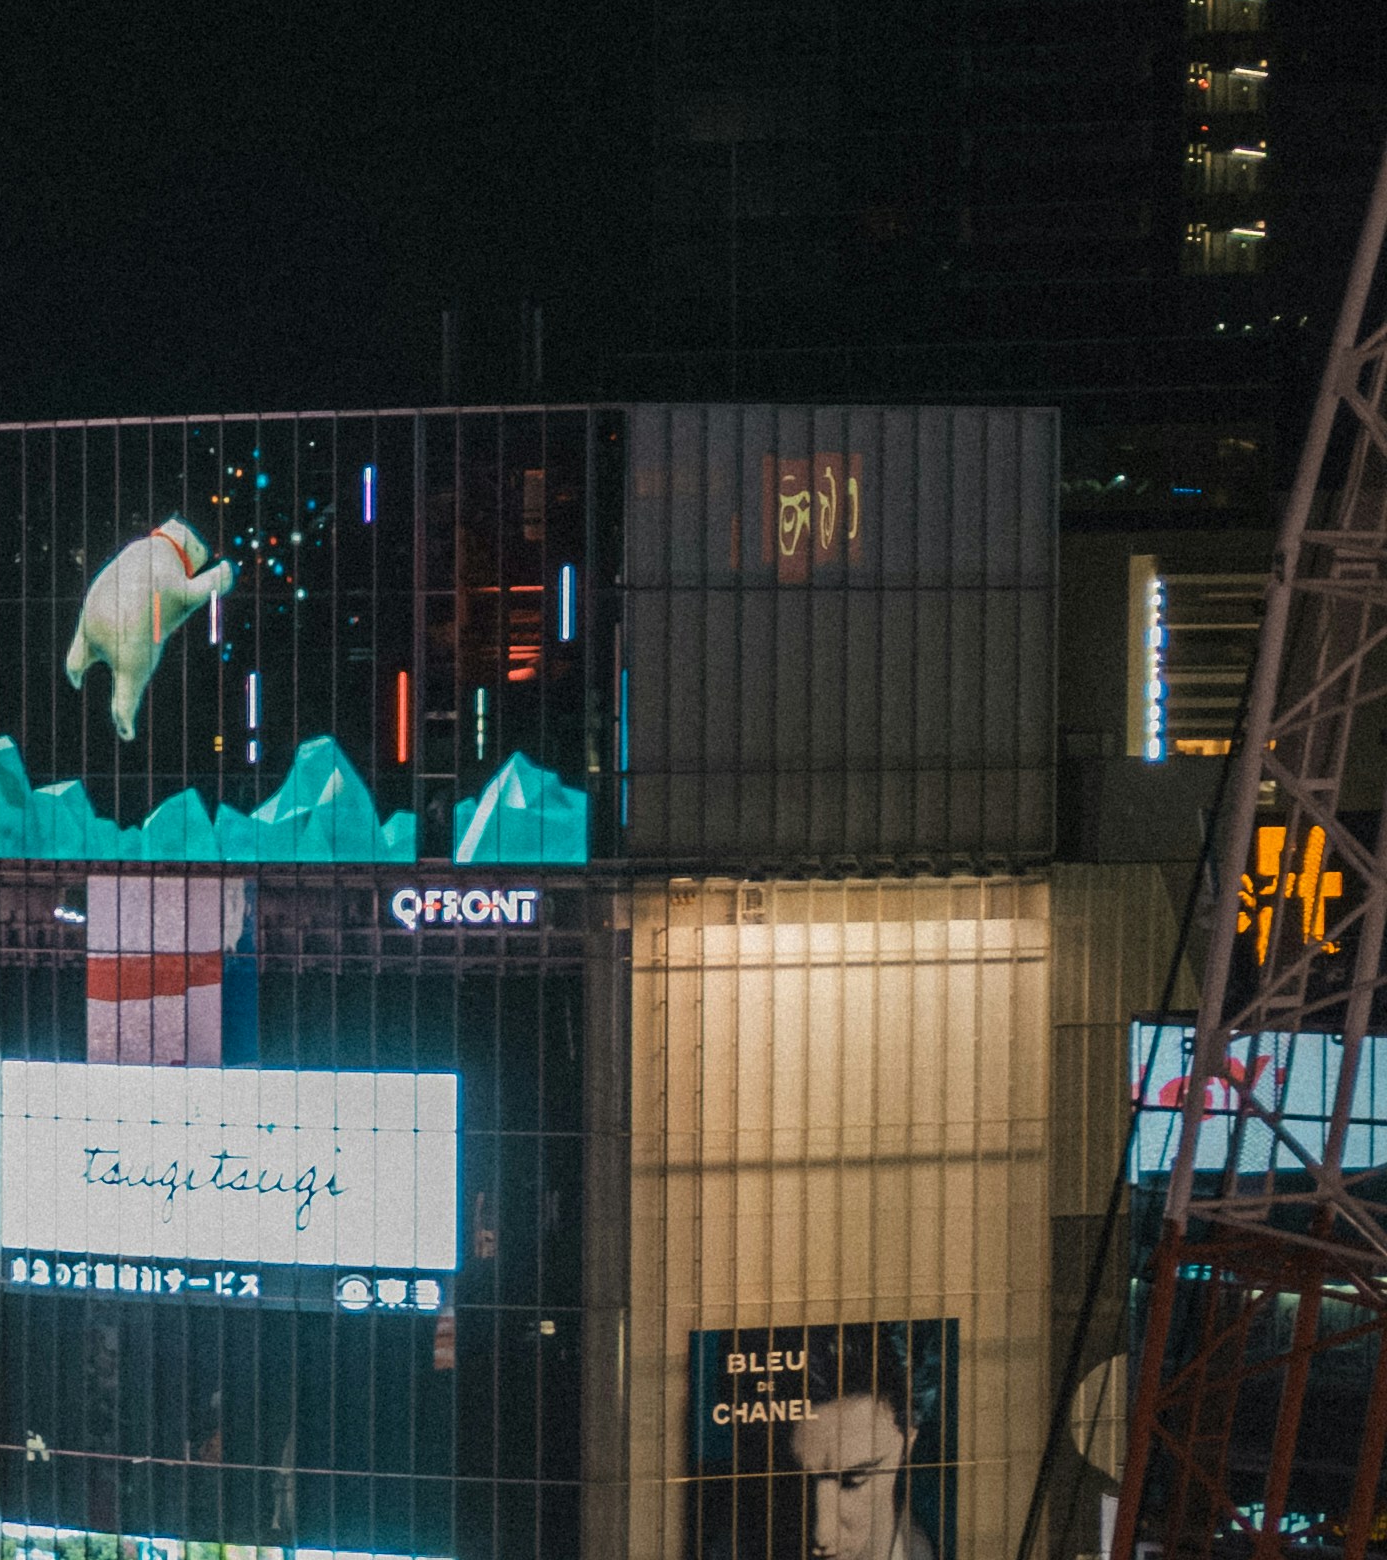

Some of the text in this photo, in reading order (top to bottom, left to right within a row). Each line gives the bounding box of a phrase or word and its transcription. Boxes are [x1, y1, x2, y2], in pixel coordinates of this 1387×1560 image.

[727, 1351, 805, 1374] BLEU
[757, 1380, 775, 1393] DE
[712, 1399, 819, 1425] CHANEL
